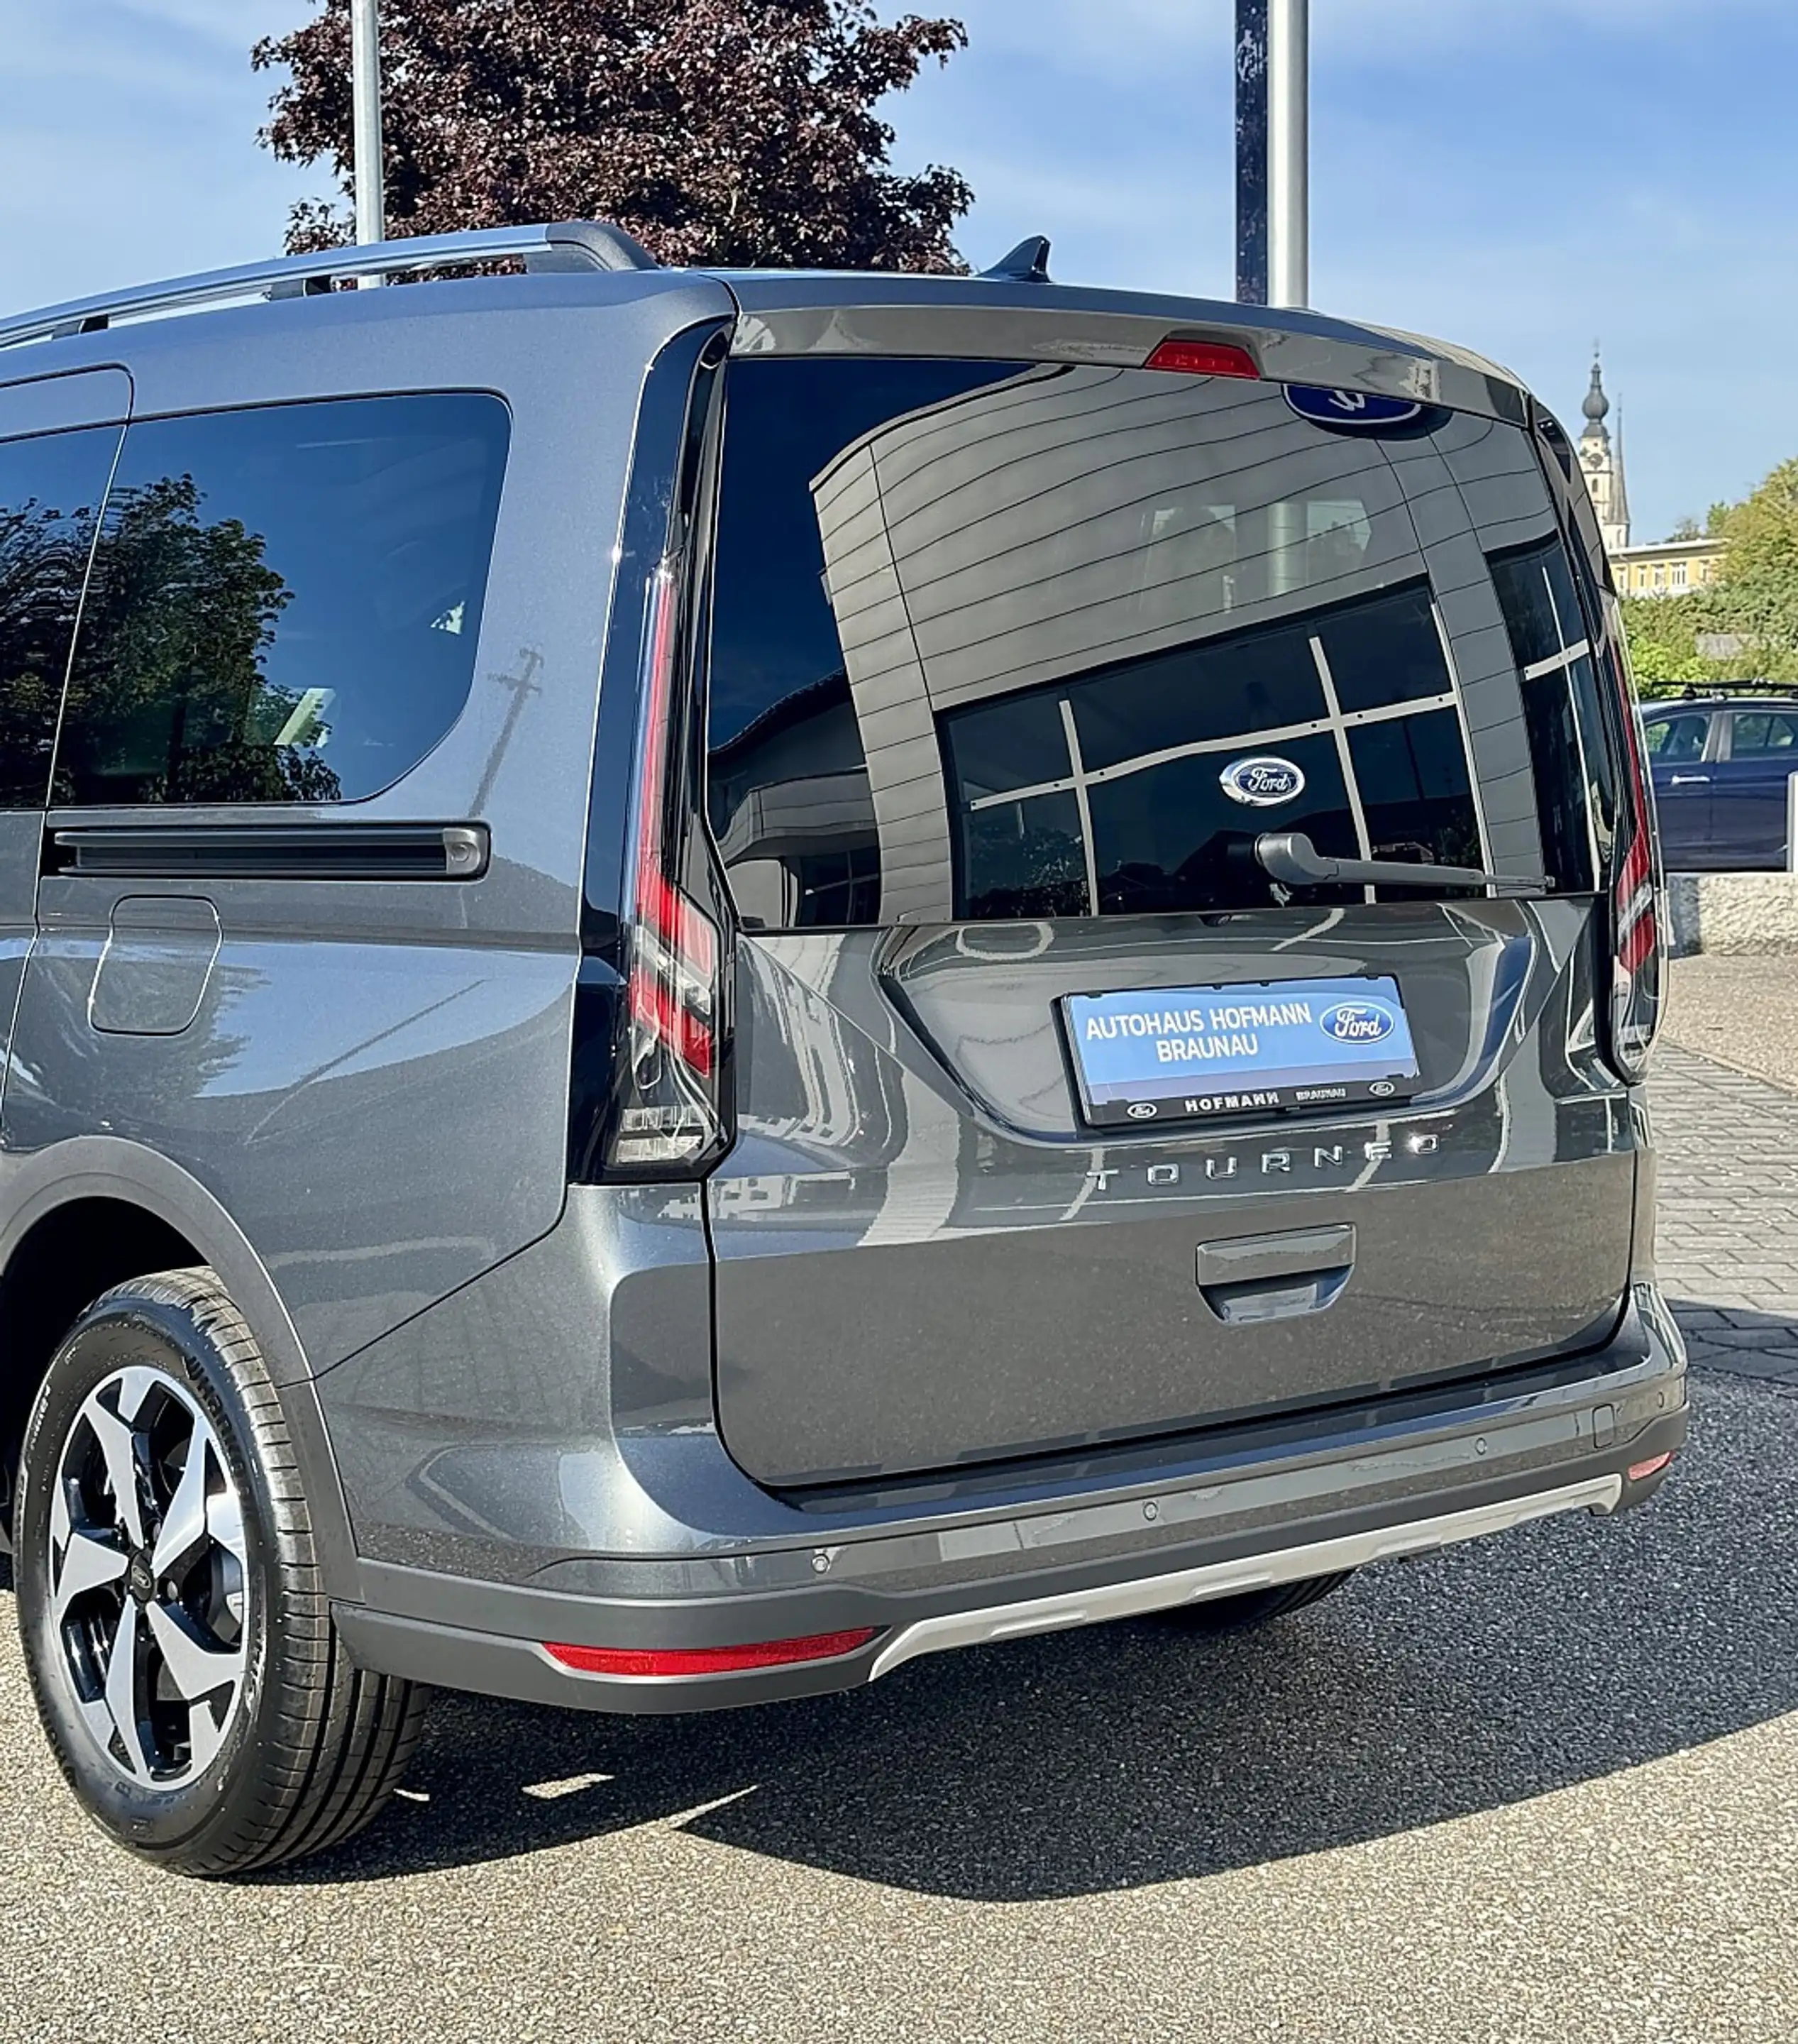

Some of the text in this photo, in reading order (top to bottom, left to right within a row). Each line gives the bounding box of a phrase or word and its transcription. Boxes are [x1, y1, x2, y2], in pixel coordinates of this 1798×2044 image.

[1247, 766, 1289, 791] Ford
[1086, 1001, 1313, 1040] AUTOHAUS HOFMANN
[1334, 1007, 1382, 1037] Ford
[1155, 1033, 1259, 1062] BRAUNAU
[1184, 1091, 1280, 1113] HOFMANN
[1086, 1134, 1440, 1191] TOURNEO
